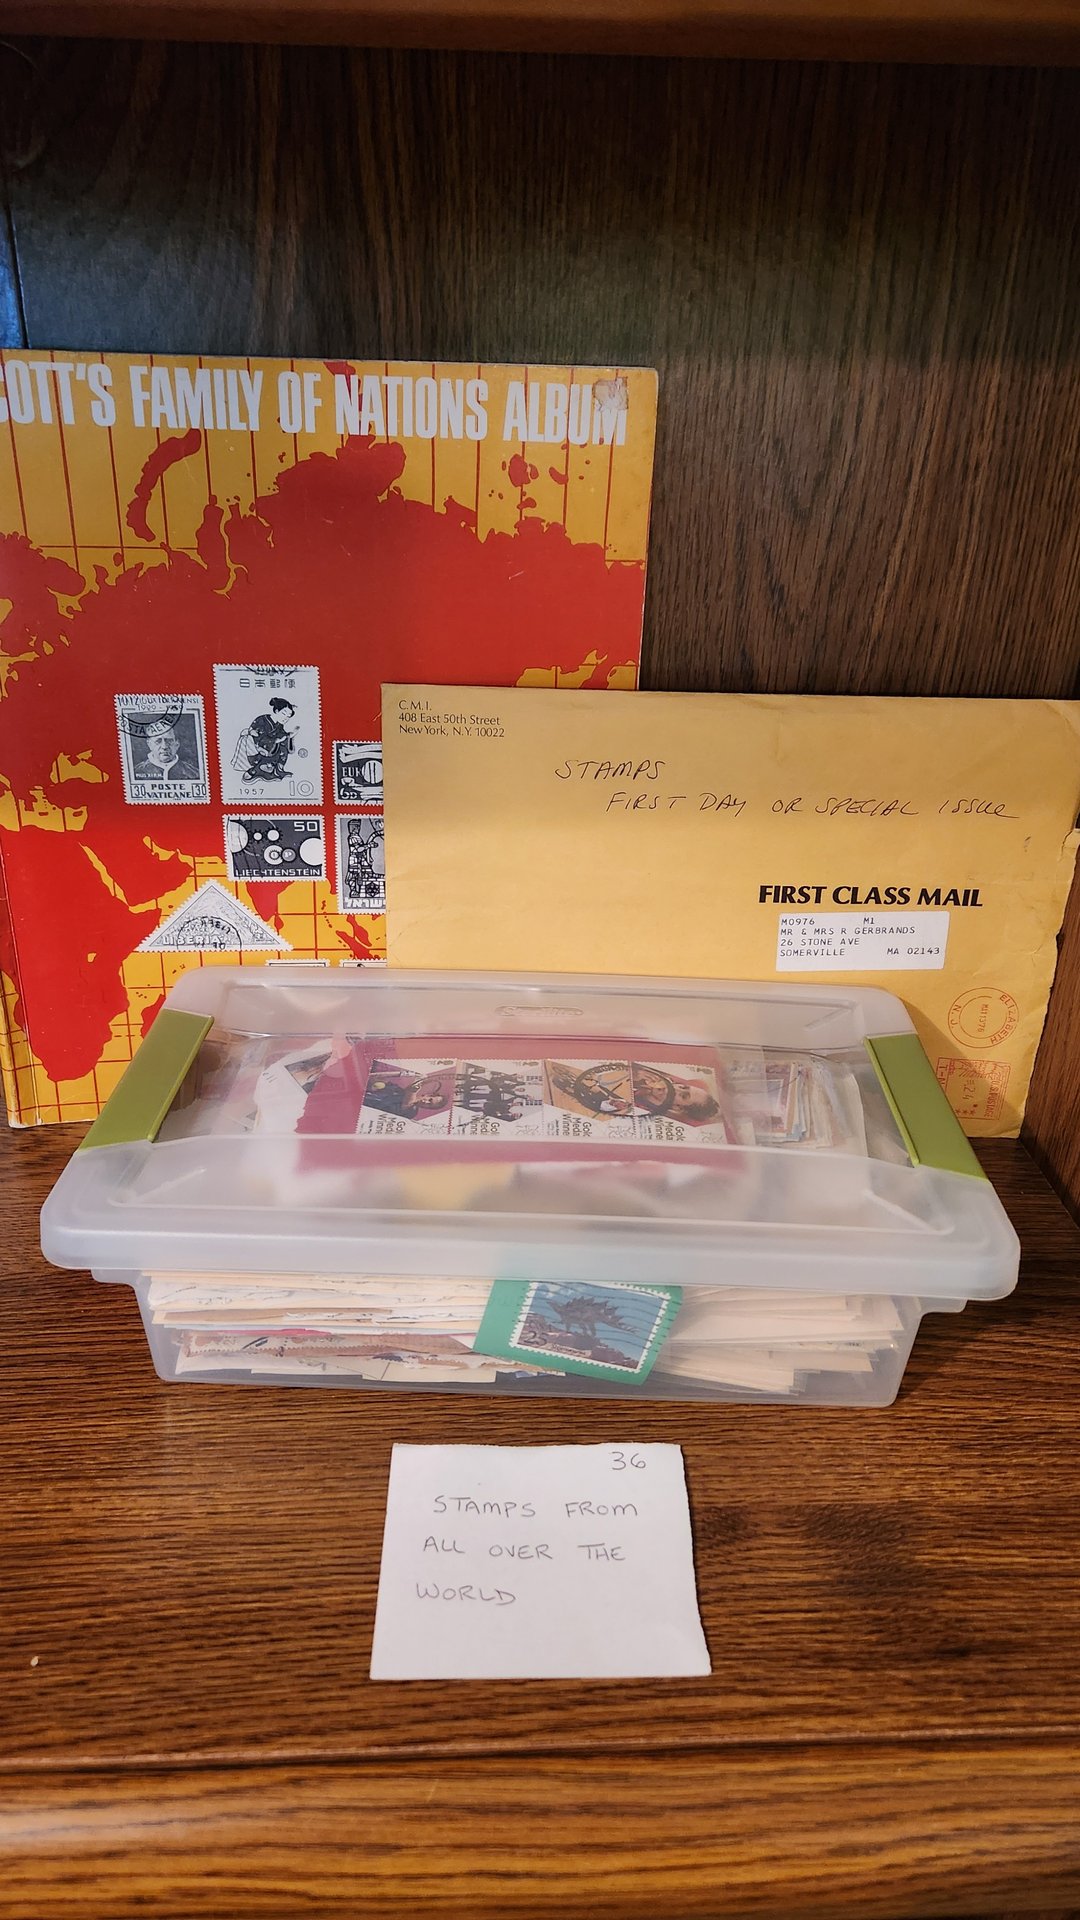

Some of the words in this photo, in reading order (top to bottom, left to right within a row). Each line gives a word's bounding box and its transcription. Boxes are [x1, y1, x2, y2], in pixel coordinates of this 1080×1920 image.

[130, 365, 264, 433] FAMILY
[278, 371, 323, 434] OF
[335, 374, 488, 441] NATIONS
[503, 381, 627, 445] ALBUM
[398, 712, 417, 722] 408
[420, 713, 440, 724] East
[443, 713, 466, 724] 50th
[469, 715, 501, 726] Street
[399, 724, 423, 734] New
[424, 725, 449, 737] York,
[475, 728, 505, 738] 10022
[554, 759, 666, 780] STAMPS
[134, 785, 146, 797] 30
[151, 783, 186, 791] POSTE
[194, 784, 207, 797] 30
[146, 791, 192, 799] VATICANE
[239, 788, 264, 796] 1957
[289, 780, 315, 797] 10
[606, 791, 687, 813] FIRST
[699, 792, 747, 818] DAY
[771, 797, 803, 815] OR
[815, 797, 919, 817] SPECIAL
[293, 821, 318, 832] 50
[759, 885, 827, 904] FIRST
[832, 886, 911, 905] CLASS
[917, 888, 983, 907] MAIL
[780, 928, 793, 936] MR
[801, 928, 807, 936] &
[813, 928, 835, 936] MRS
[840, 927, 848, 935] R
[162, 935, 223, 945] LIBERIA
[780, 938, 793, 947] 26
[801, 938, 833, 946] STONE
[840, 937, 860, 946] AVE
[780, 949, 846, 957] SOMERVILLE
[886, 947, 900, 955] MA
[907, 946, 940, 955] 02143
[990, 993, 1017, 1044] ELIZABETH
[523, 1330, 548, 1346] 25
[610, 1451, 647, 1471] 36
[433, 1495, 536, 1518] STAMPS
[564, 1501, 638, 1518] FROM
[423, 1535, 466, 1554] ALL
[488, 1543, 553, 1560] OVER
[577, 1543, 626, 1561] THE
[416, 1582, 516, 1606] WORLD
